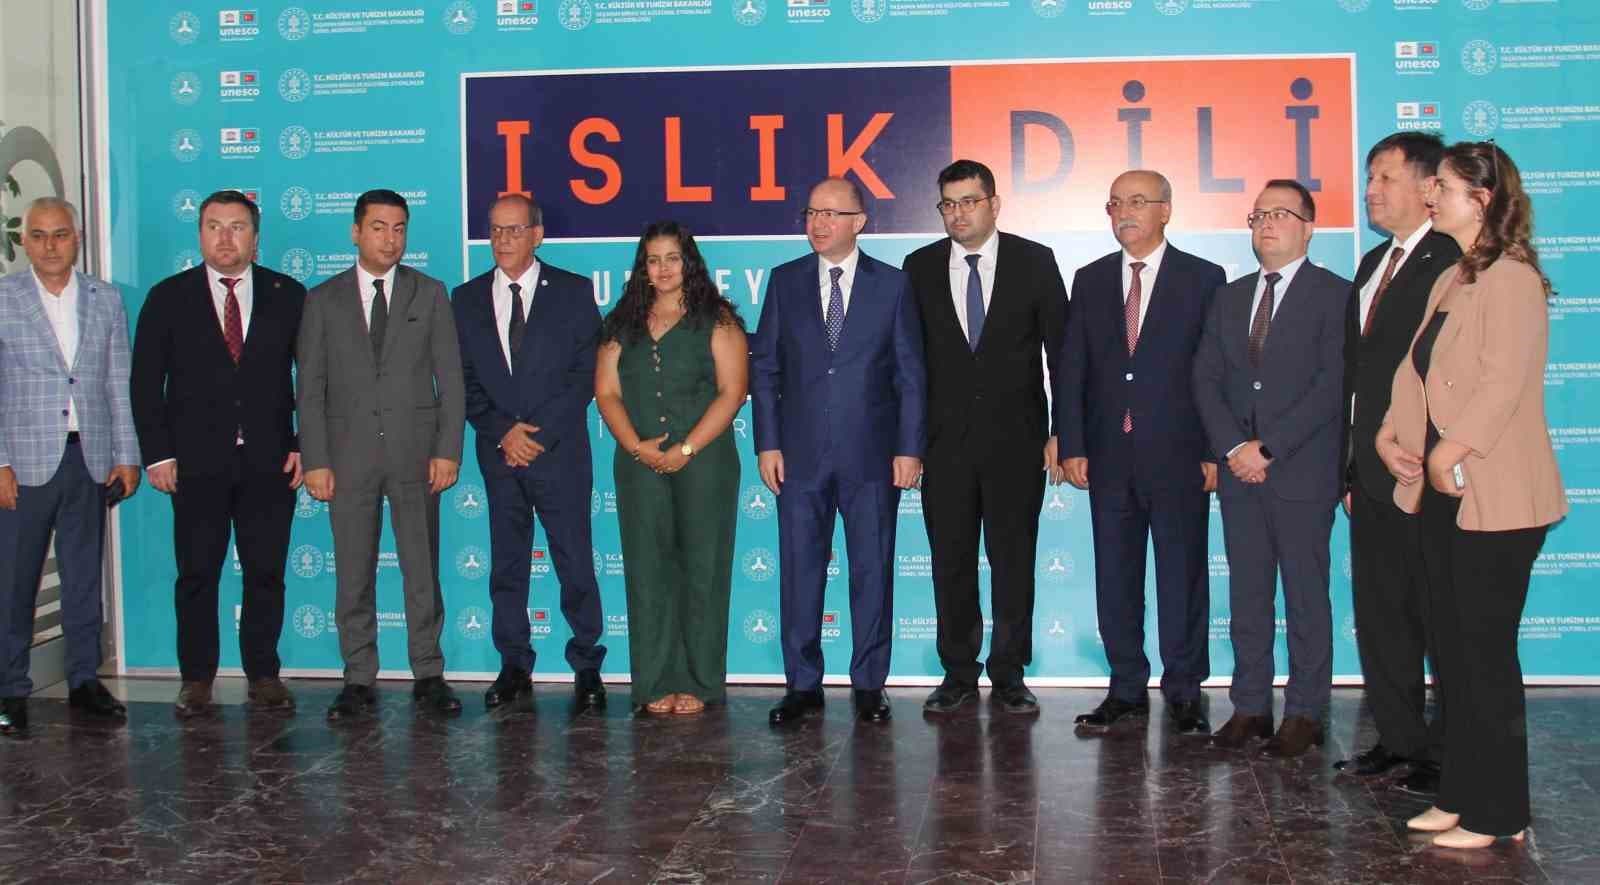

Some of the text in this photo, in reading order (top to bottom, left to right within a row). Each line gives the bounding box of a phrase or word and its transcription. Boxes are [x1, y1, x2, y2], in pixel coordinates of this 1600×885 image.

[1088, 0, 1132, 9] unesco
[787, 7, 830, 17] unesco
[497, 16, 538, 26] unesco
[219, 27, 259, 36] unesco
[1395, 59, 1440, 68] unesco
[220, 87, 260, 97] unesco
[1397, 120, 1441, 129] unesco
[496, 77, 1322, 205] ISLIK DİLİ
[221, 144, 260, 154] unesco
